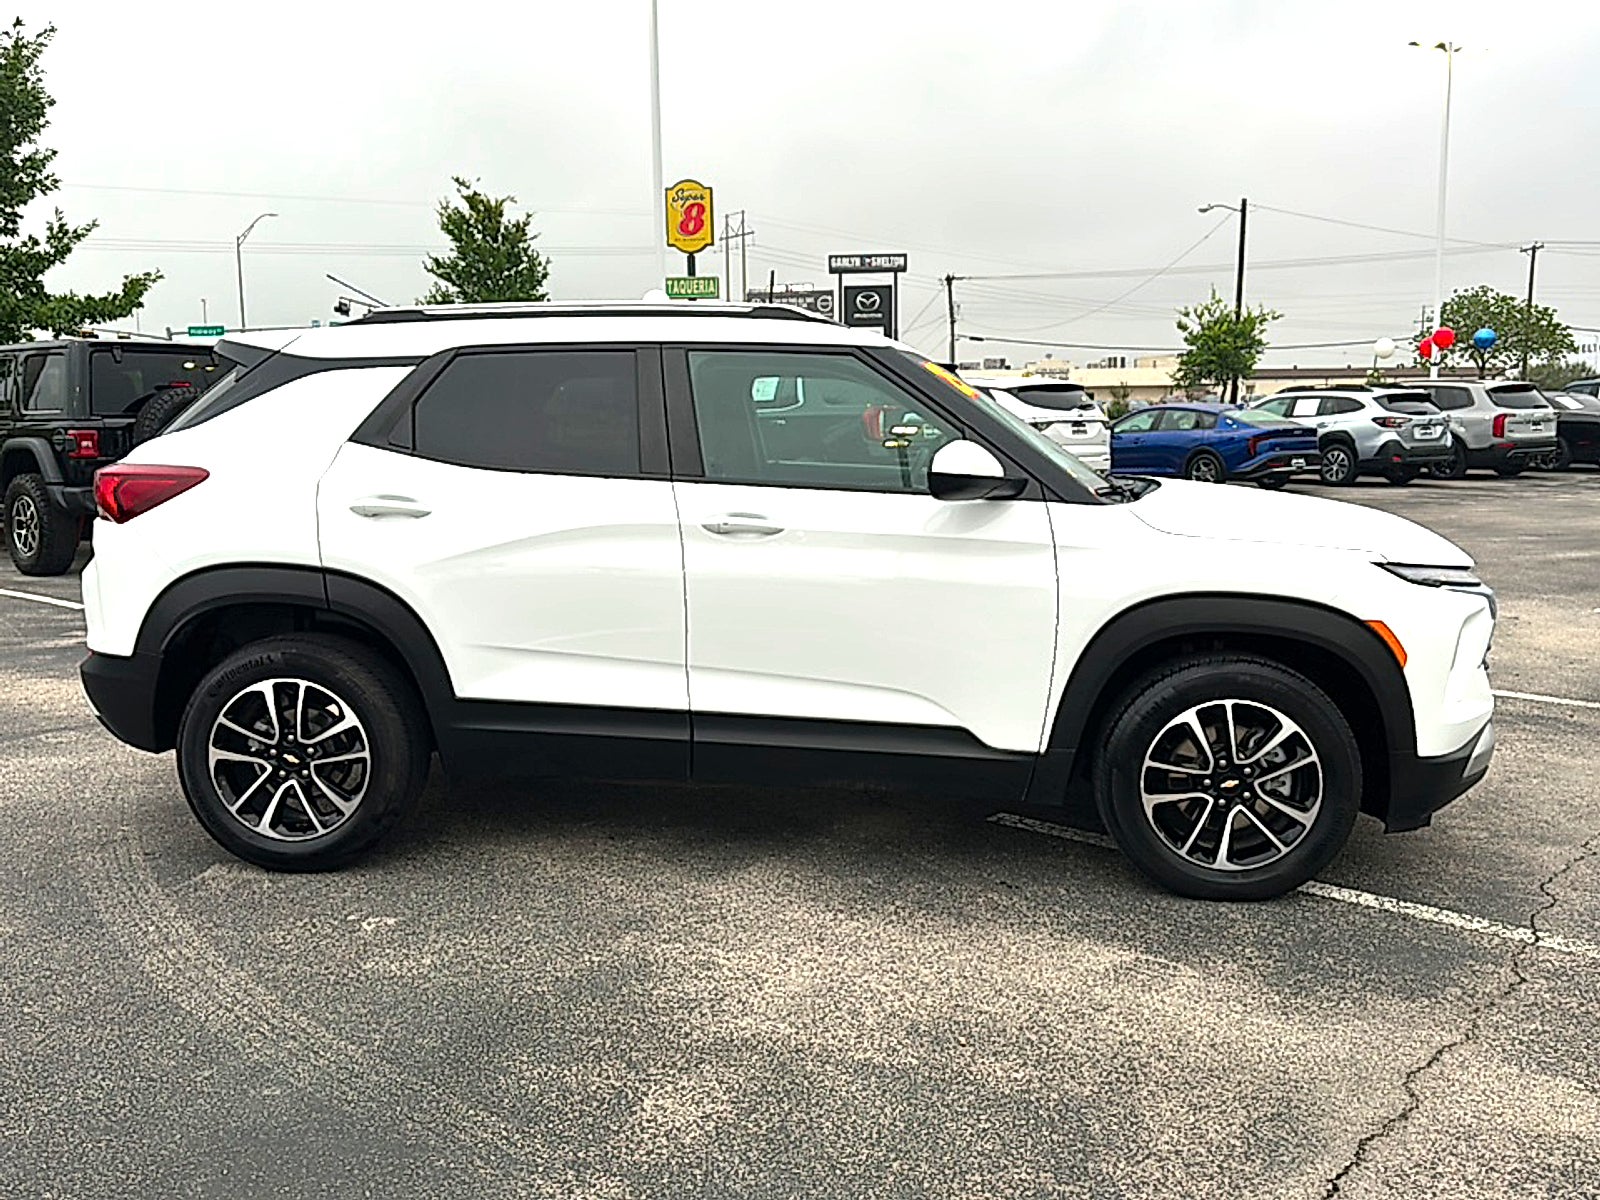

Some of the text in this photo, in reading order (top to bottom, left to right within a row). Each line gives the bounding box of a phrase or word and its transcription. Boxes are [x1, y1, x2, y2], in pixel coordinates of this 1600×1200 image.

[672, 188, 705, 208] Super
[680, 203, 705, 235] 8
[667, 279, 716, 295] TAQUERIA
